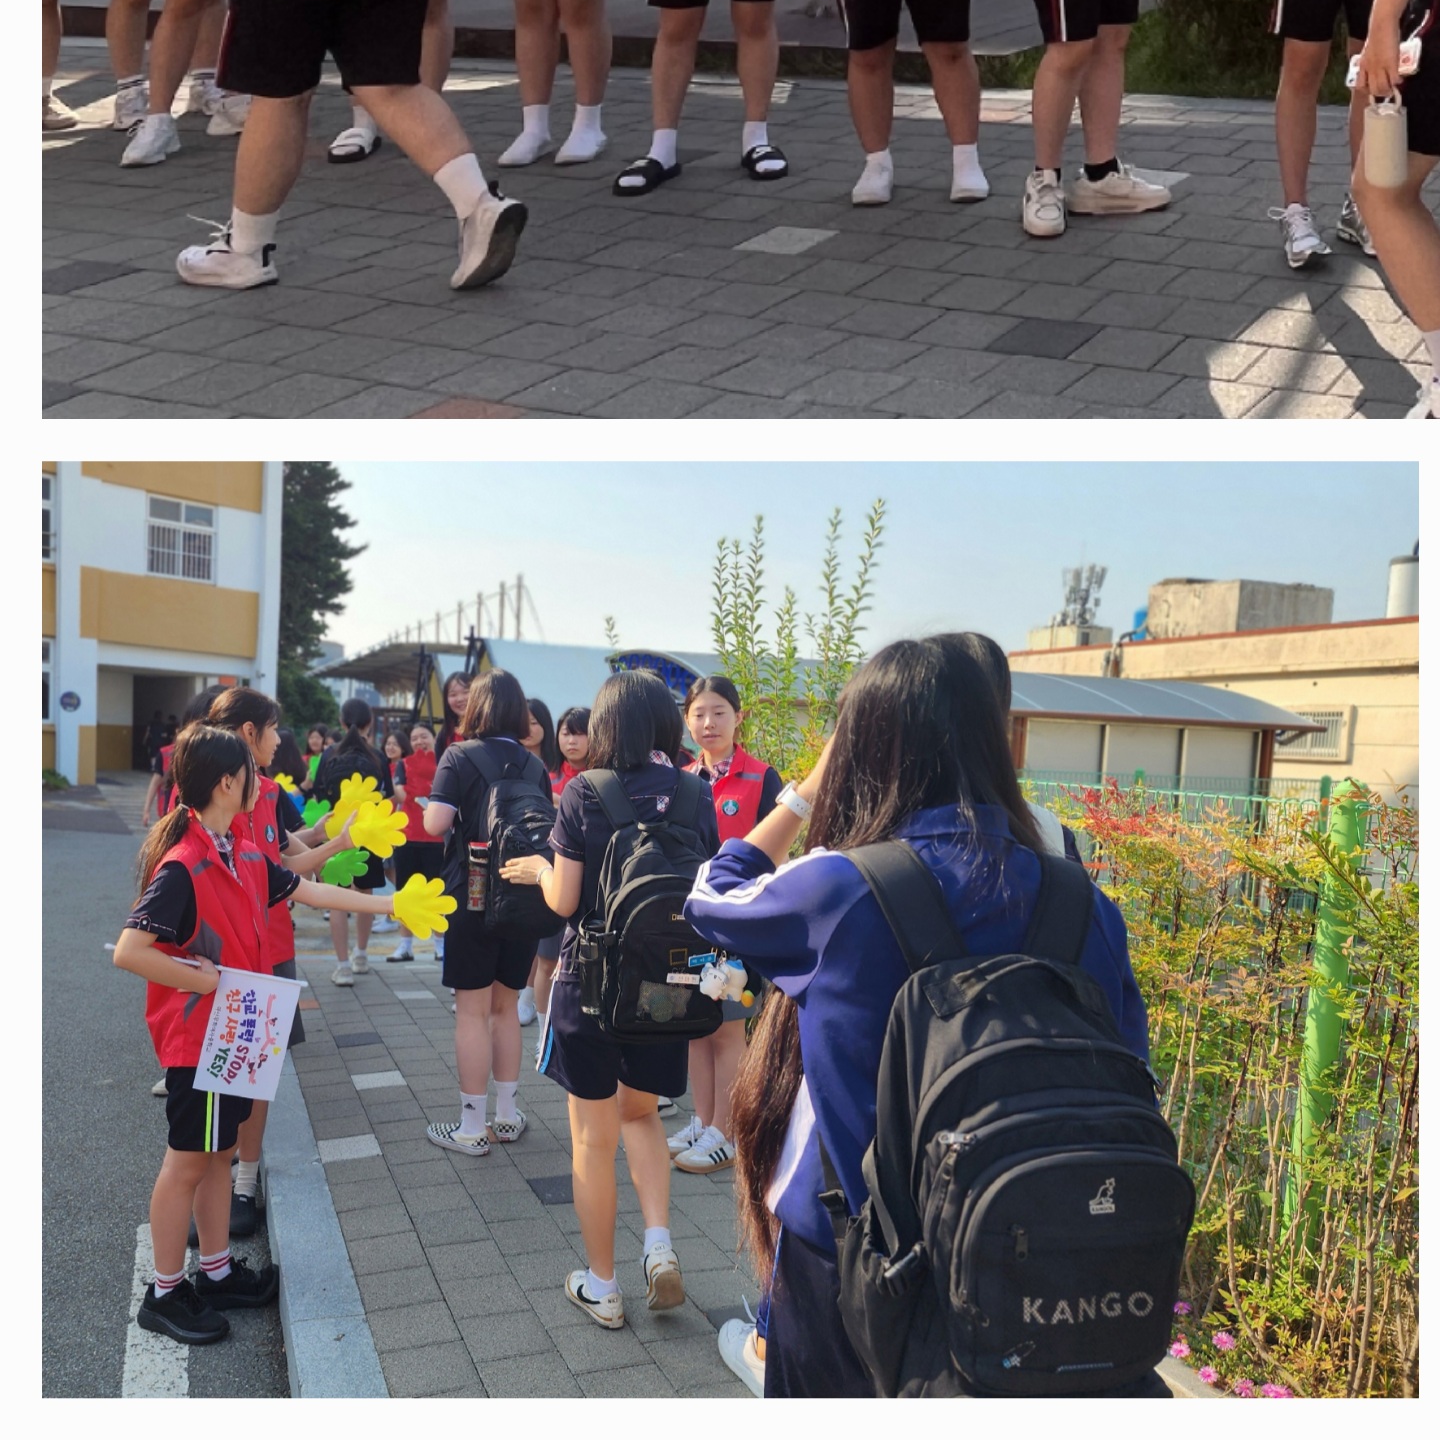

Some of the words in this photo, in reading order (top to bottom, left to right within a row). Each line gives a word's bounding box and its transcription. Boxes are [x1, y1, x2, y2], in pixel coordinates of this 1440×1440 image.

[226, 989, 241, 1014] 친구
[241, 989, 256, 1015] 학교
[219, 1016, 239, 1045] 사랑
[238, 1019, 256, 1042] 폭력
[207, 1047, 231, 1078] YES!
[221, 1045, 249, 1085] STOP!
[1022, 1291, 1154, 1325] KANGO
